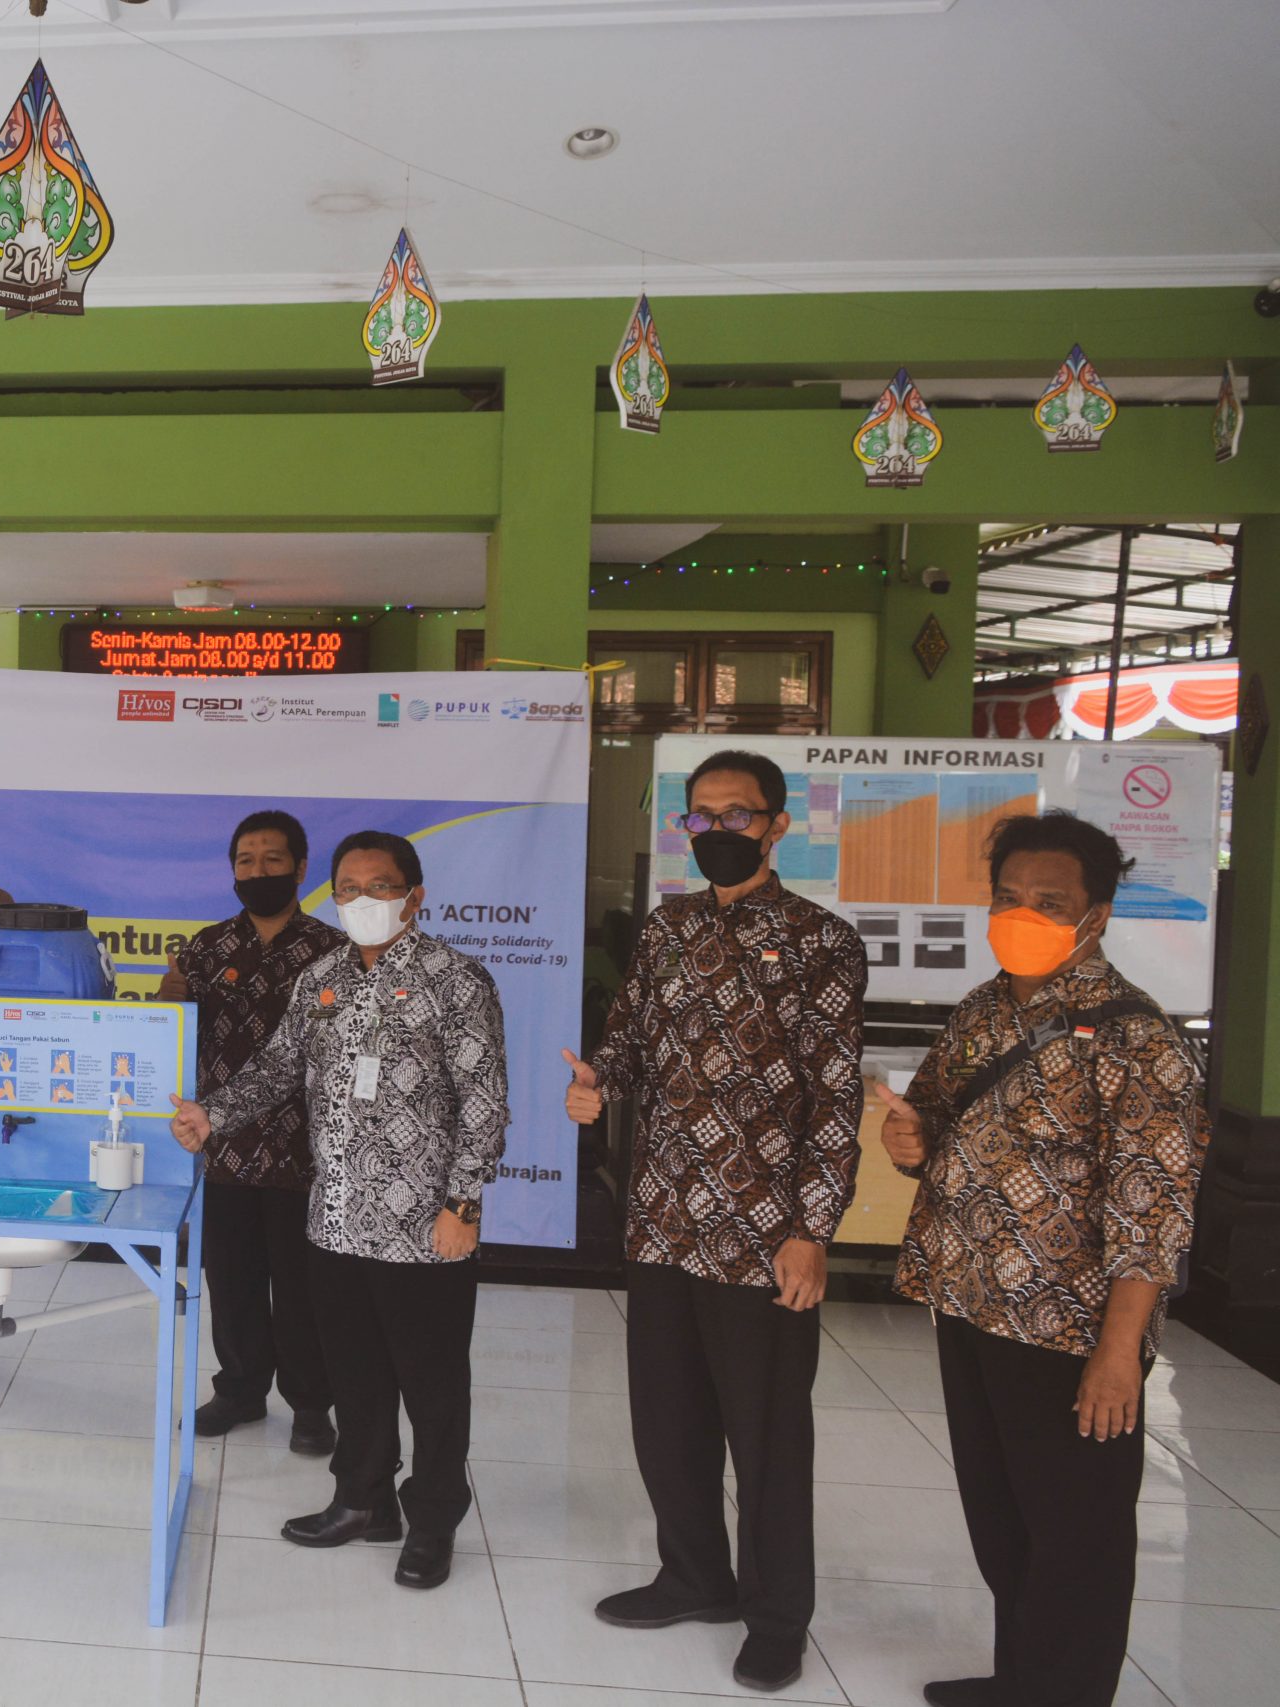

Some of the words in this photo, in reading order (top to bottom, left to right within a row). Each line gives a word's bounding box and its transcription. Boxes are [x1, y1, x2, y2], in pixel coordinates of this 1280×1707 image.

[3, 242, 54, 286] 264
[27, 293, 45, 303] JOGJA
[381, 337, 411, 368] 264
[632, 392, 655, 417] 264
[1056, 423, 1092, 441] 264
[876, 455, 915, 475] 264
[91, 631, 192, 649] Senin-Kamis
[193, 632, 231, 649] Jam
[100, 650, 157, 667] Jumat
[158, 650, 197, 667] Jam
[252, 651, 280, 670] s/d
[283, 651, 335, 670] 11.00
[122, 694, 172, 711] Hivos
[182, 697, 243, 711] CISDI
[529, 702, 584, 717] Sapda
[281, 708, 313, 716] KAPAL
[316, 709, 367, 718] Perempuan
[806, 748, 888, 764] PAPAN
[904, 750, 1044, 768] INFORMASI
[1119, 811, 1170, 821] KAWASAN
[1110, 823, 1142, 832] TANPA
[434, 934, 489, 948] Building
[491, 935, 554, 950] Solidarity
[490, 953, 503, 964] to
[507, 953, 568, 968] Covid-19)
